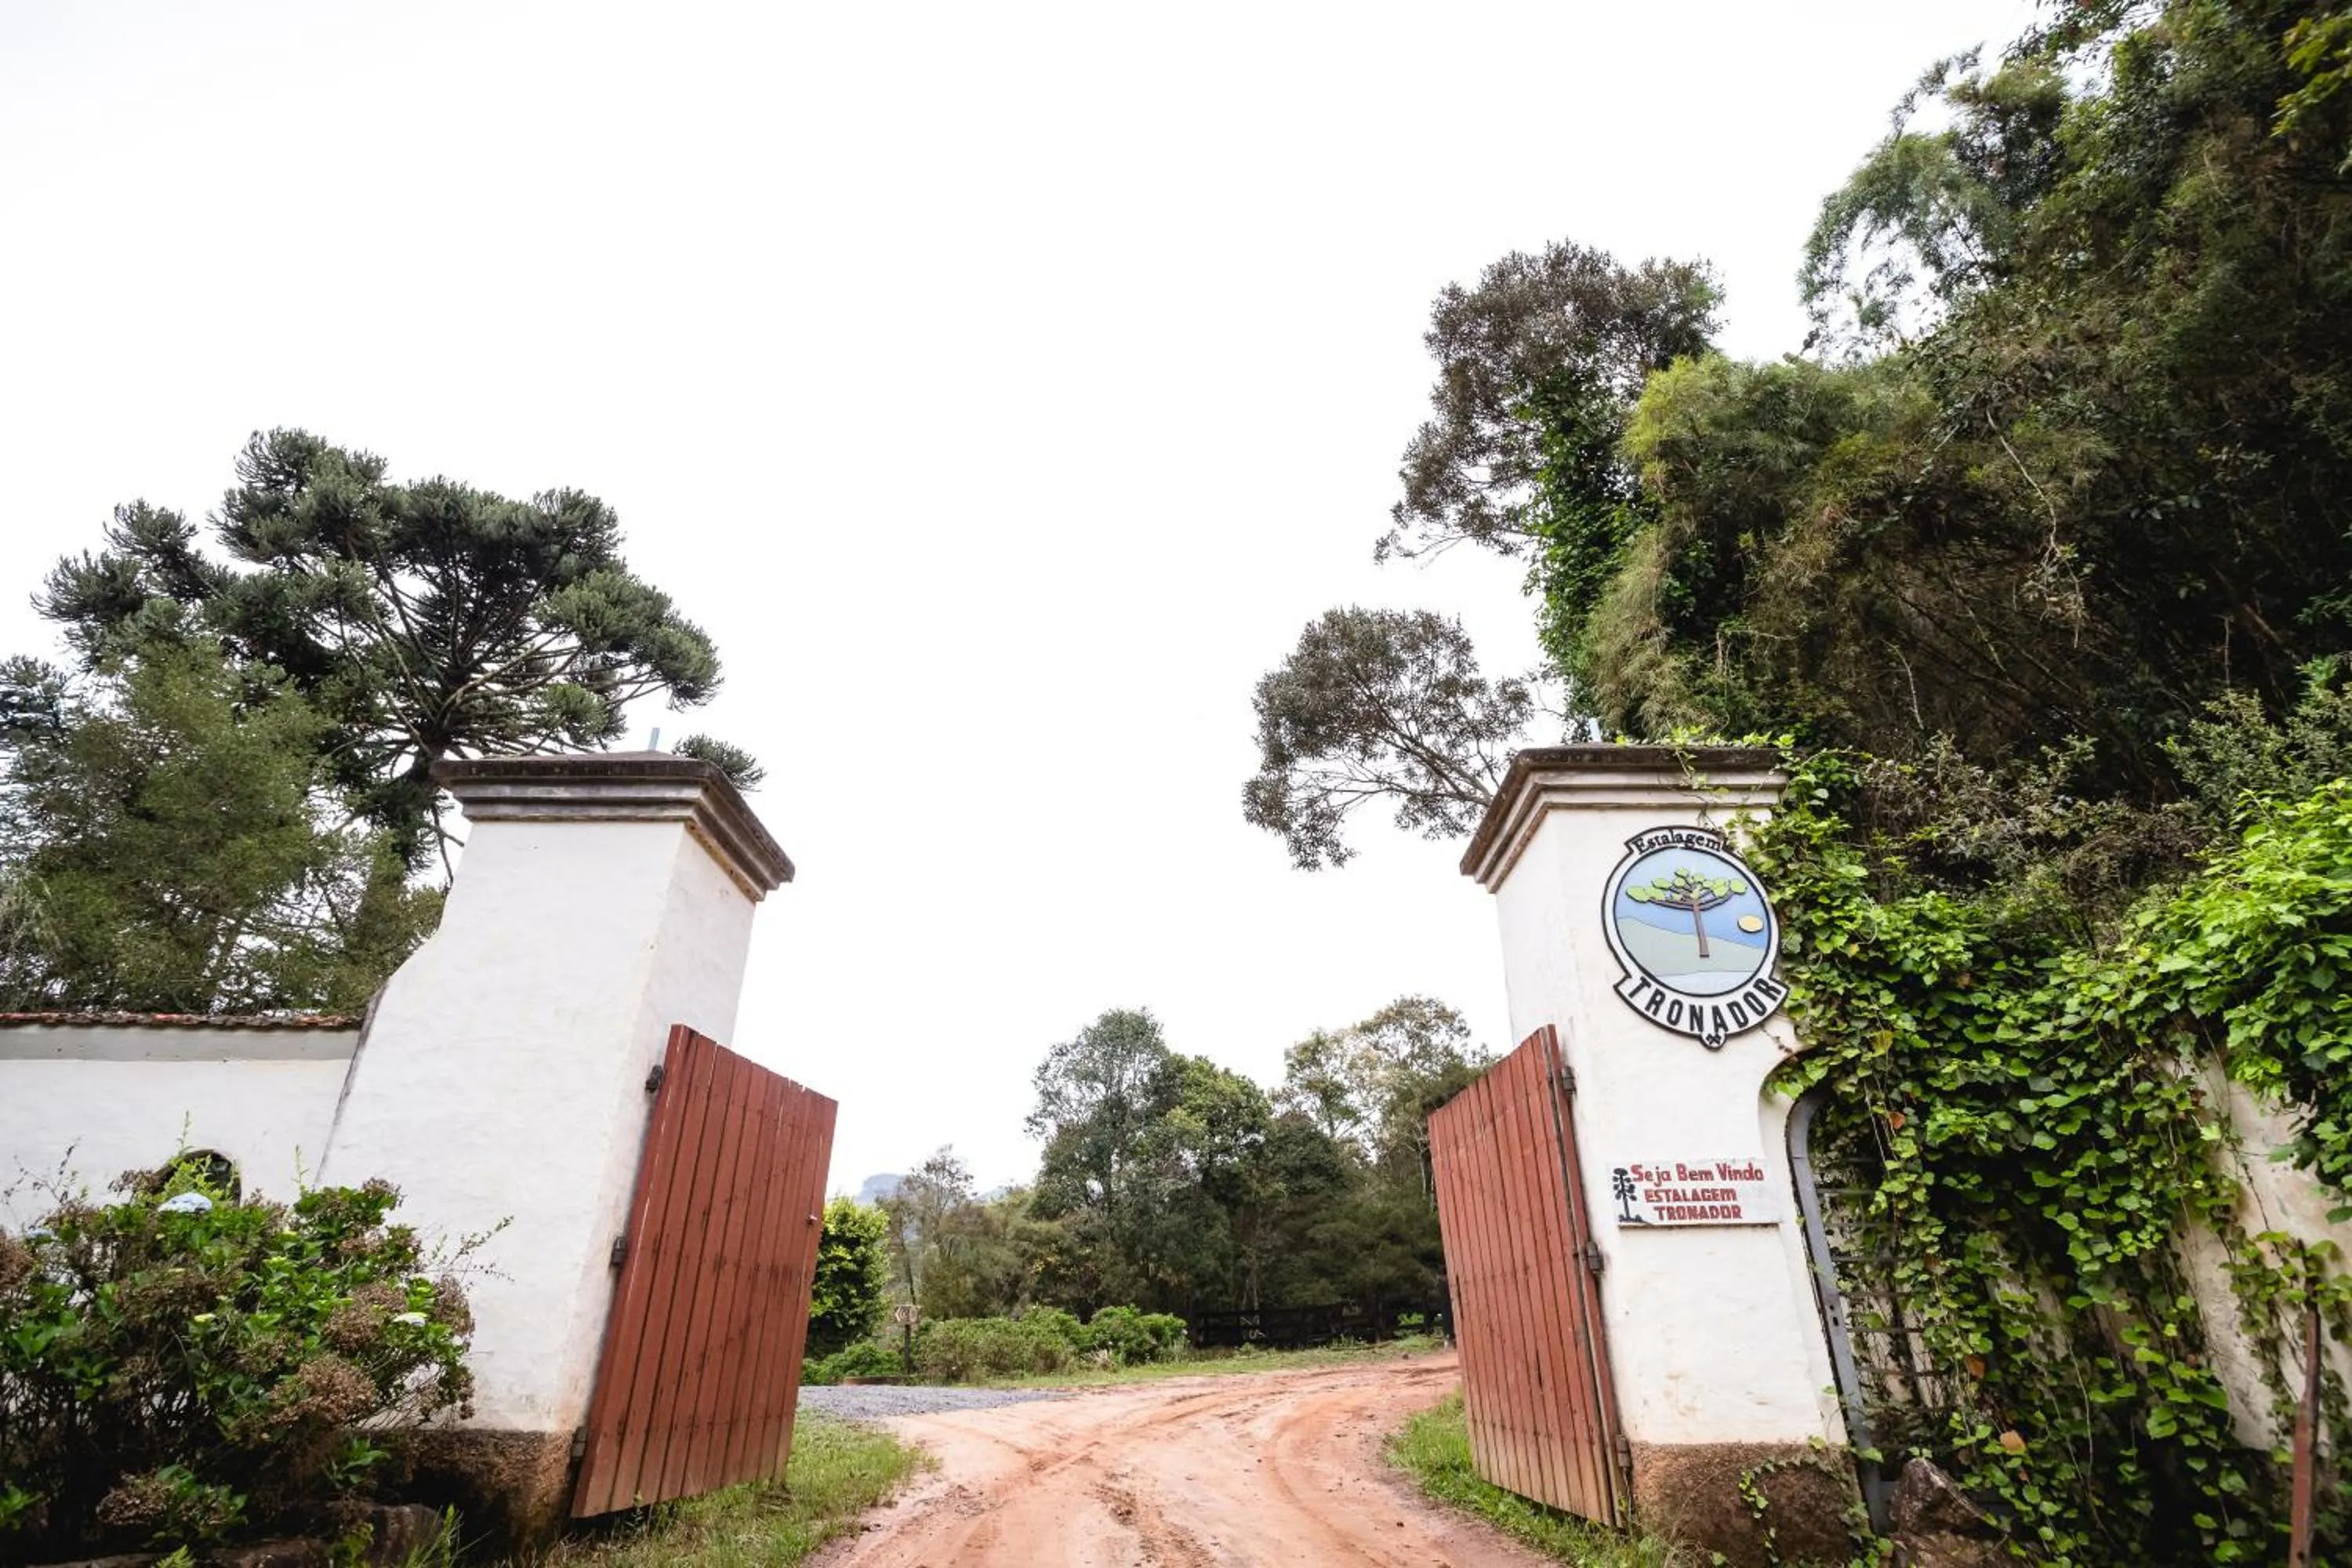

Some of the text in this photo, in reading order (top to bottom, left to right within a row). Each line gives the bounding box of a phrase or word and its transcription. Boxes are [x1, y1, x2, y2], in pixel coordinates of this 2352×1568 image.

[1632, 829, 1721, 855] Estalagem
[1628, 977, 1783, 1033] TRONADOR
[1630, 1162, 1764, 1187] Seja Bem Vindo
[1653, 1204, 1743, 1220] TRONADOR
